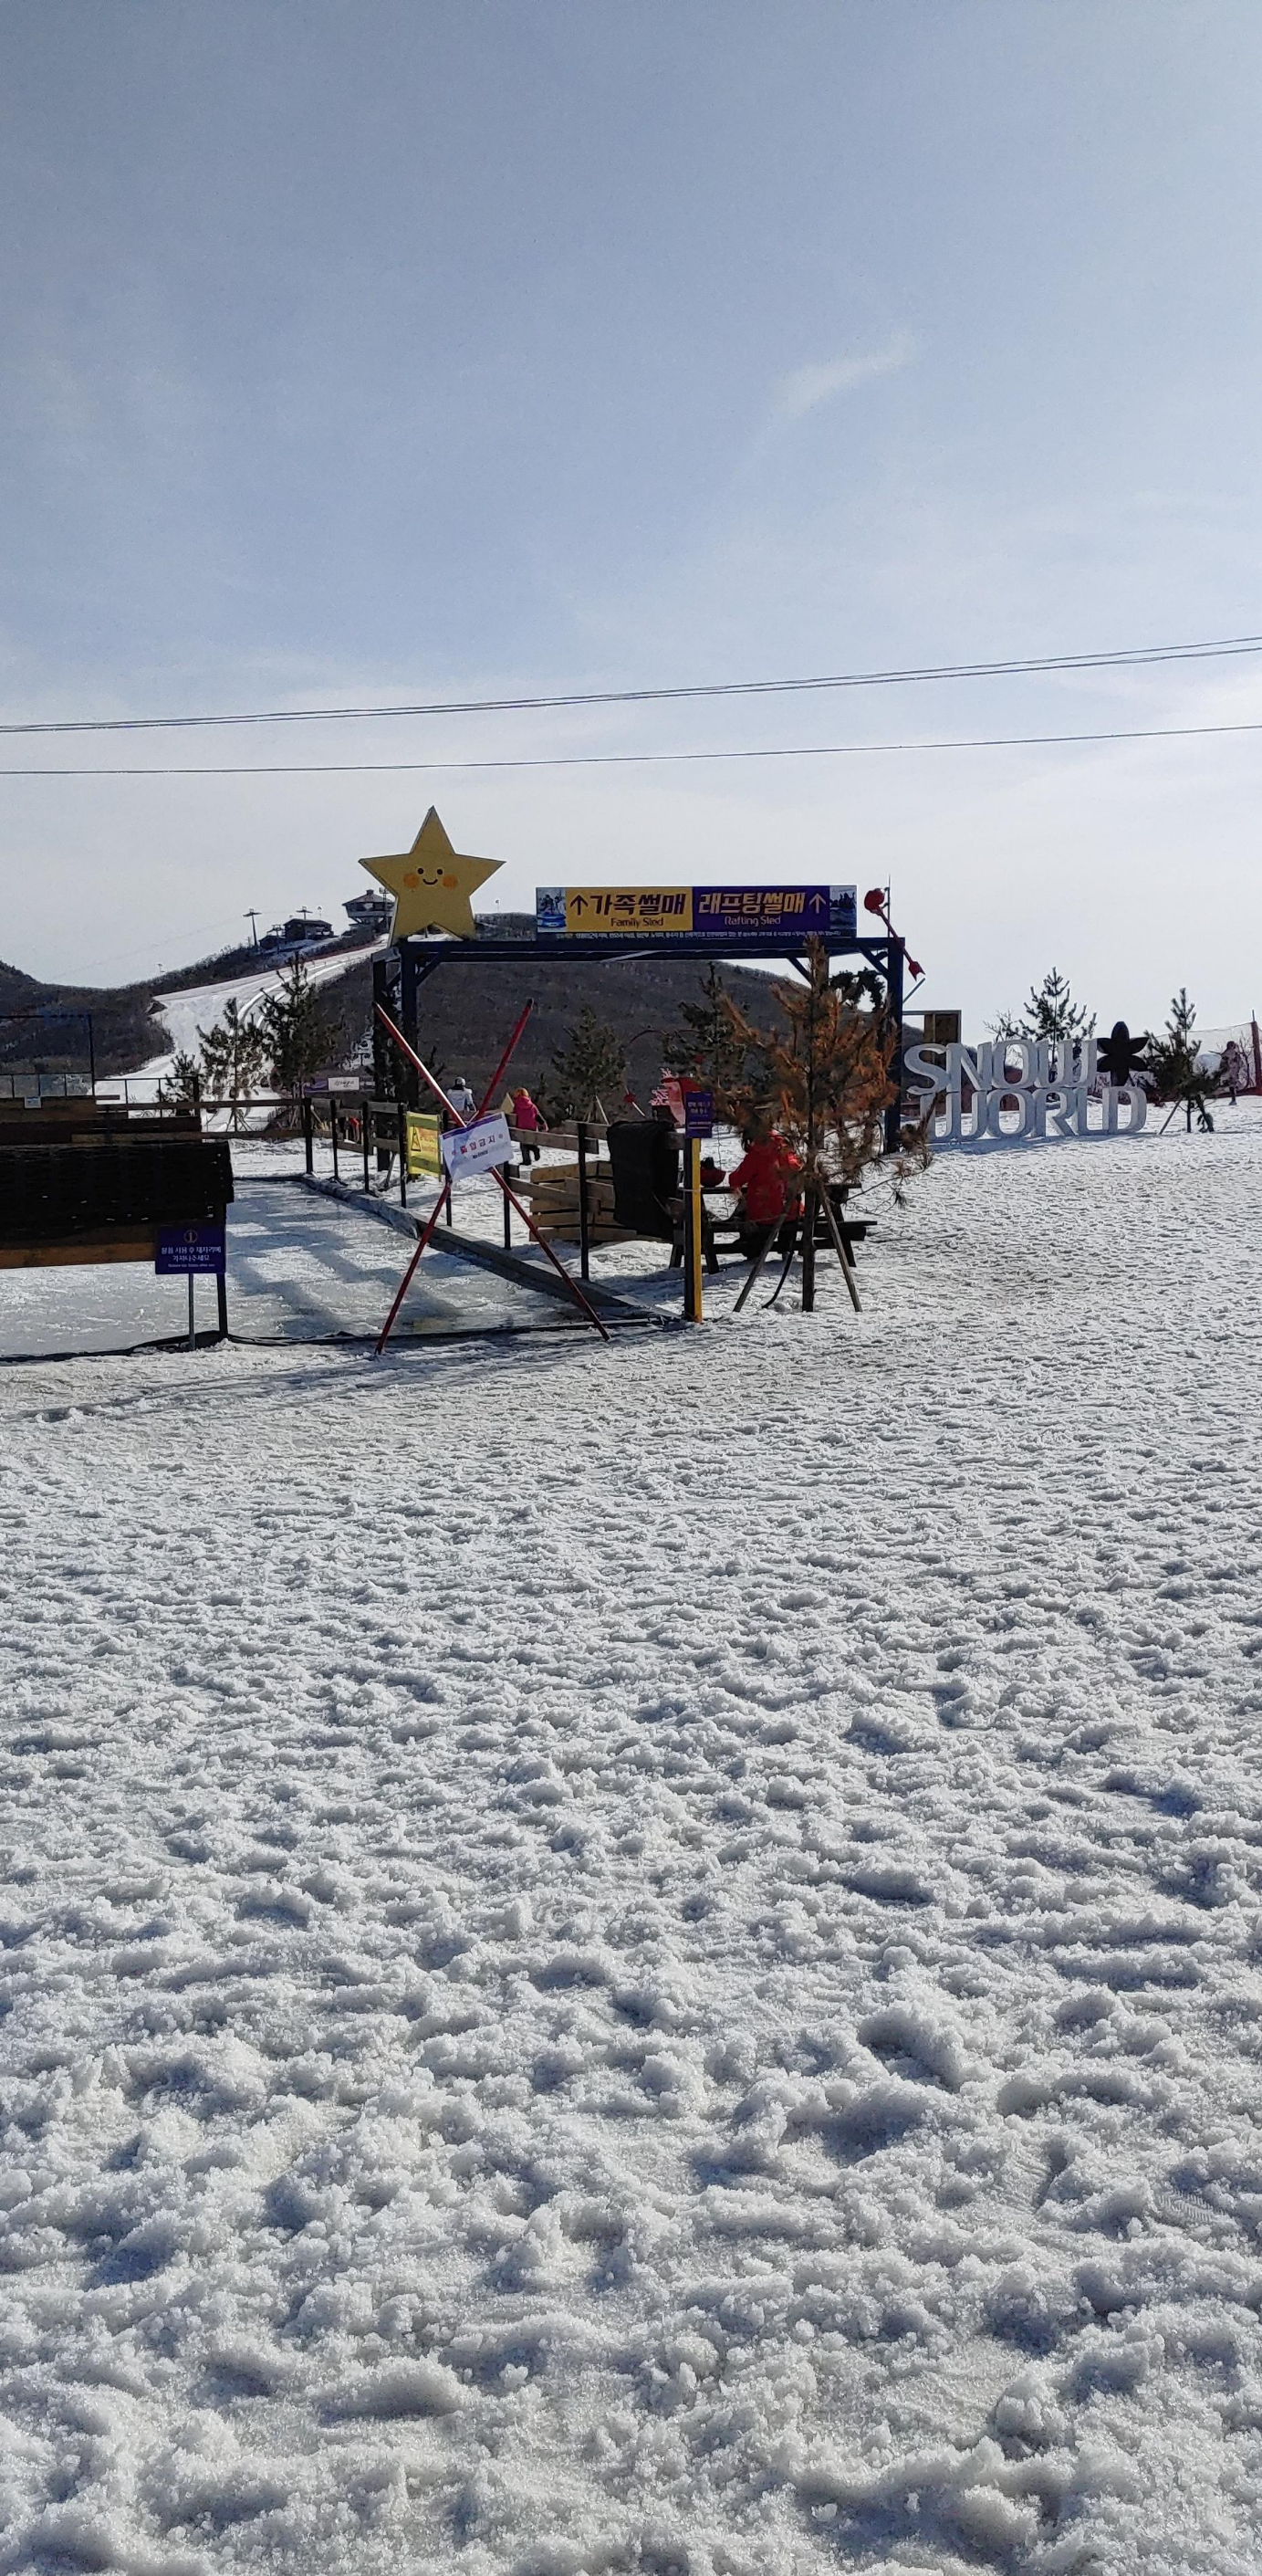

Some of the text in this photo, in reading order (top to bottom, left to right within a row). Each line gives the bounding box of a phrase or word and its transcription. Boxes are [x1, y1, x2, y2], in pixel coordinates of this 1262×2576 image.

[589, 893, 686, 916] 가족썰매
[698, 892, 806, 914] 래프팅썰매
[610, 916, 664, 929] Family Sled
[725, 915, 781, 927] Rafting Sled
[904, 1041, 1098, 1094] SNOW
[920, 1086, 1147, 1143] WORLD
